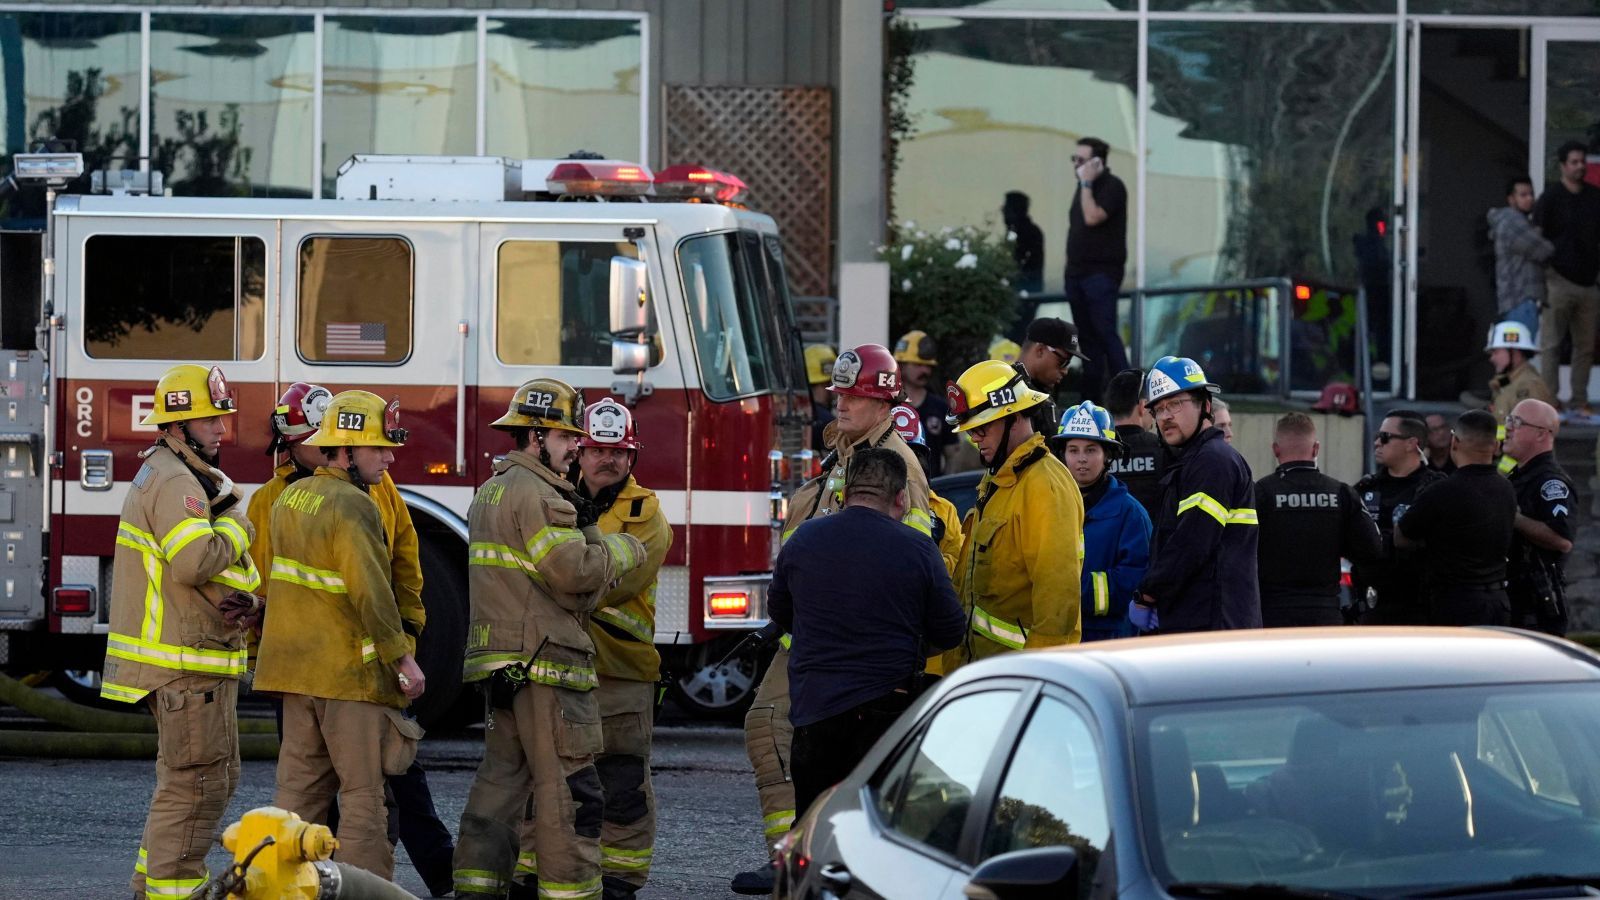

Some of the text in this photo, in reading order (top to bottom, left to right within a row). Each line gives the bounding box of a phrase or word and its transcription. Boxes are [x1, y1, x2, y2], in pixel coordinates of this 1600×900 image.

[878, 372, 896, 388] E4
[1150, 376, 1168, 389] CARE
[989, 391, 998, 407] E
[1000, 388, 1015, 404] 12
[1152, 385, 1170, 396] EMT
[167, 391, 189, 406] E5
[526, 391, 552, 406] E12
[338, 413, 361, 429] E 12
[1071, 417, 1092, 425] CARE
[1108, 457, 1155, 472] OLICE
[1275, 493, 1338, 508] POLICE
